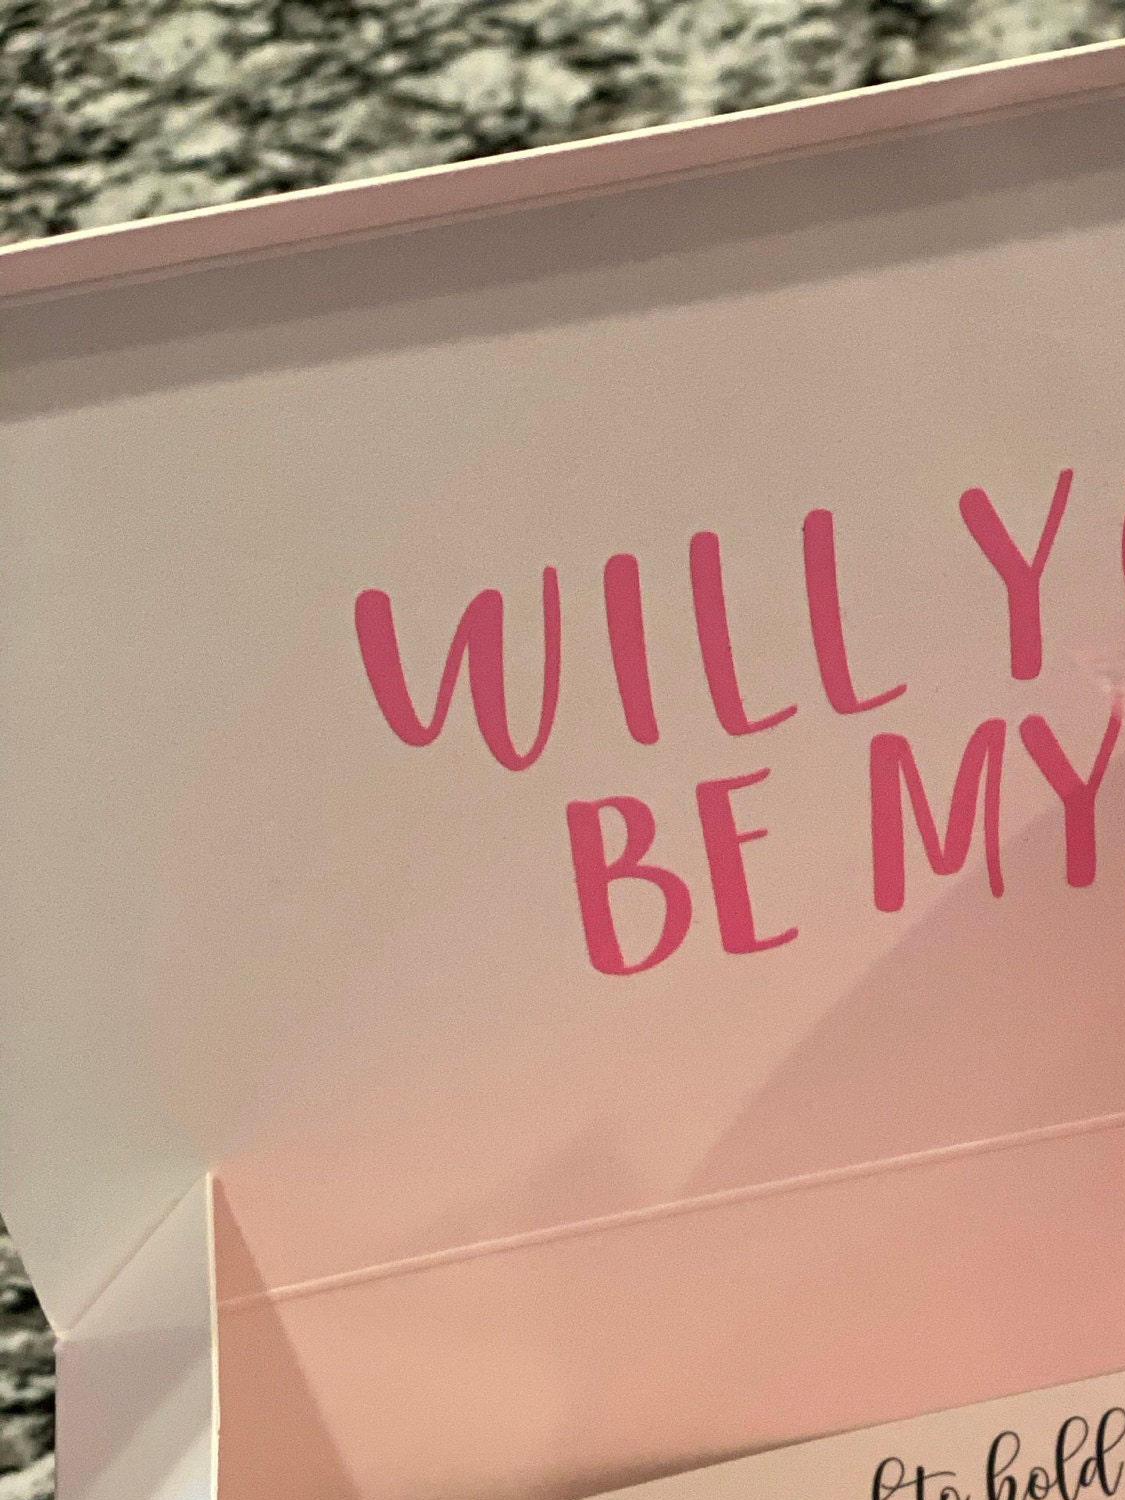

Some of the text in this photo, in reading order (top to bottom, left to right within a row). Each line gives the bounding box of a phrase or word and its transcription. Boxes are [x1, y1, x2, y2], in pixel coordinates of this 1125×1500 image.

[354, 508, 907, 771] WILL
[566, 694, 1123, 976] BE MY
